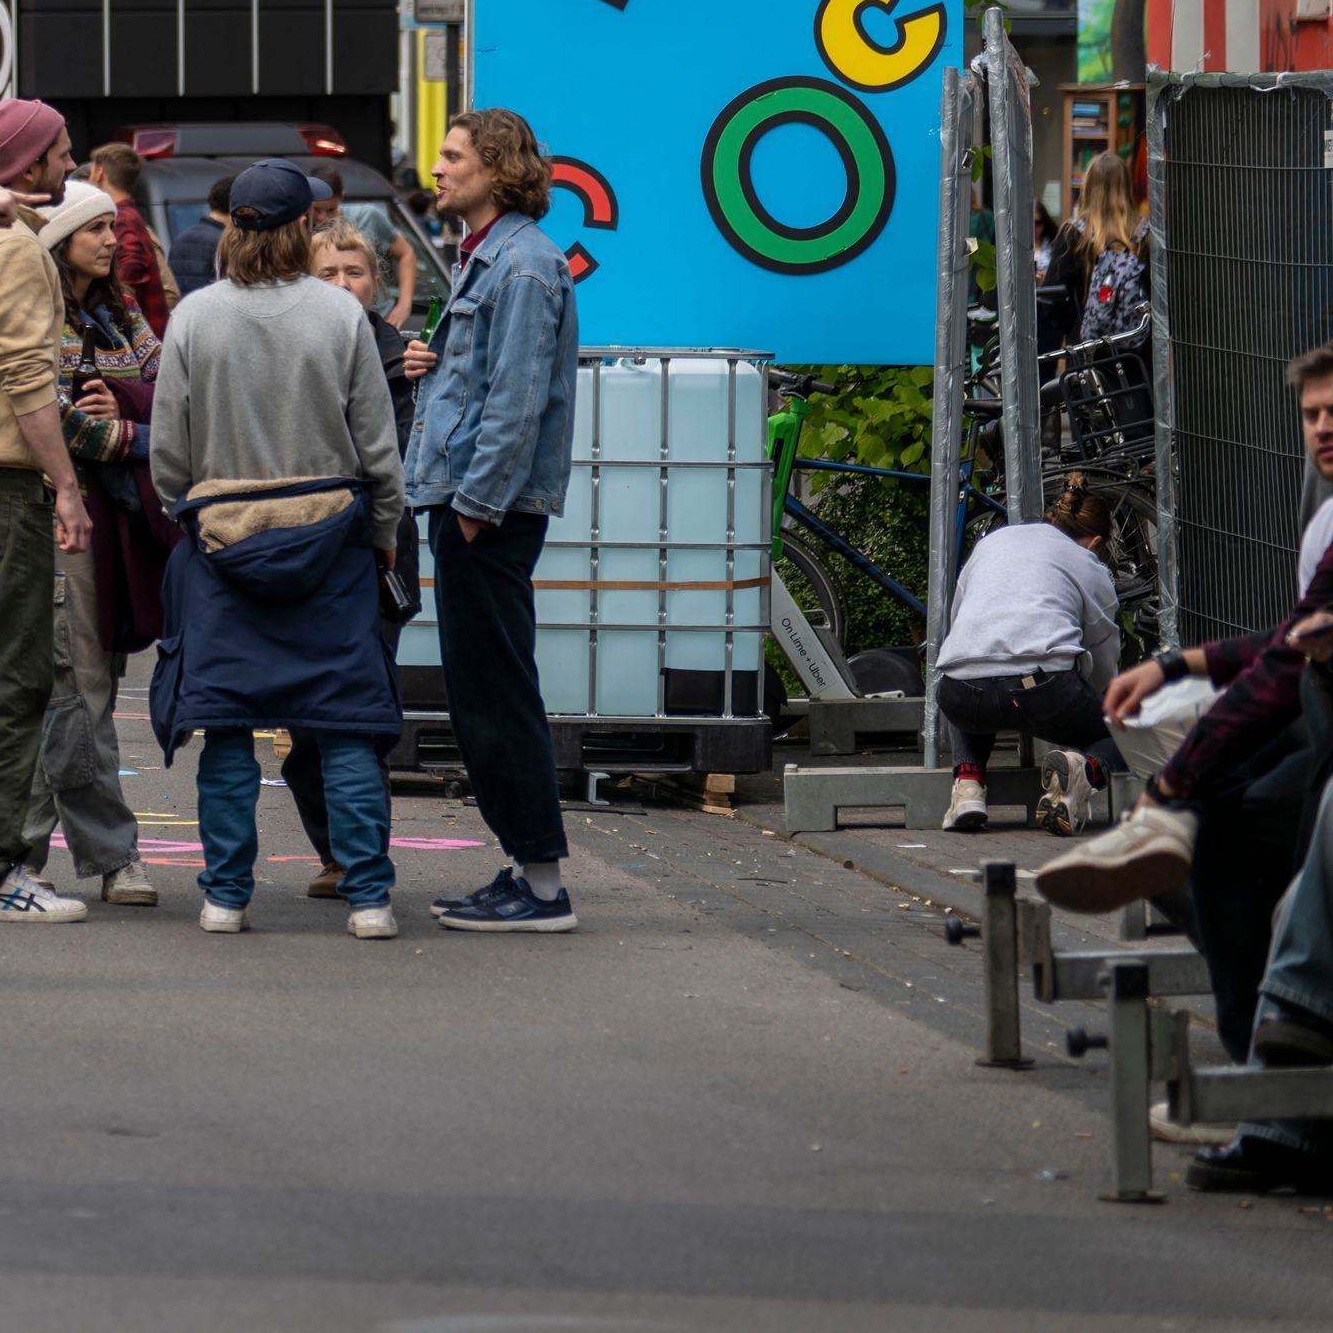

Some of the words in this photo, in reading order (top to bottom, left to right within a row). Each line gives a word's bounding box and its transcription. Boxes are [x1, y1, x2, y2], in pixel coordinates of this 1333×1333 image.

[781, 617, 793, 634] On
[790, 632, 807, 656] Lime
[809, 662, 826, 687] Uber
